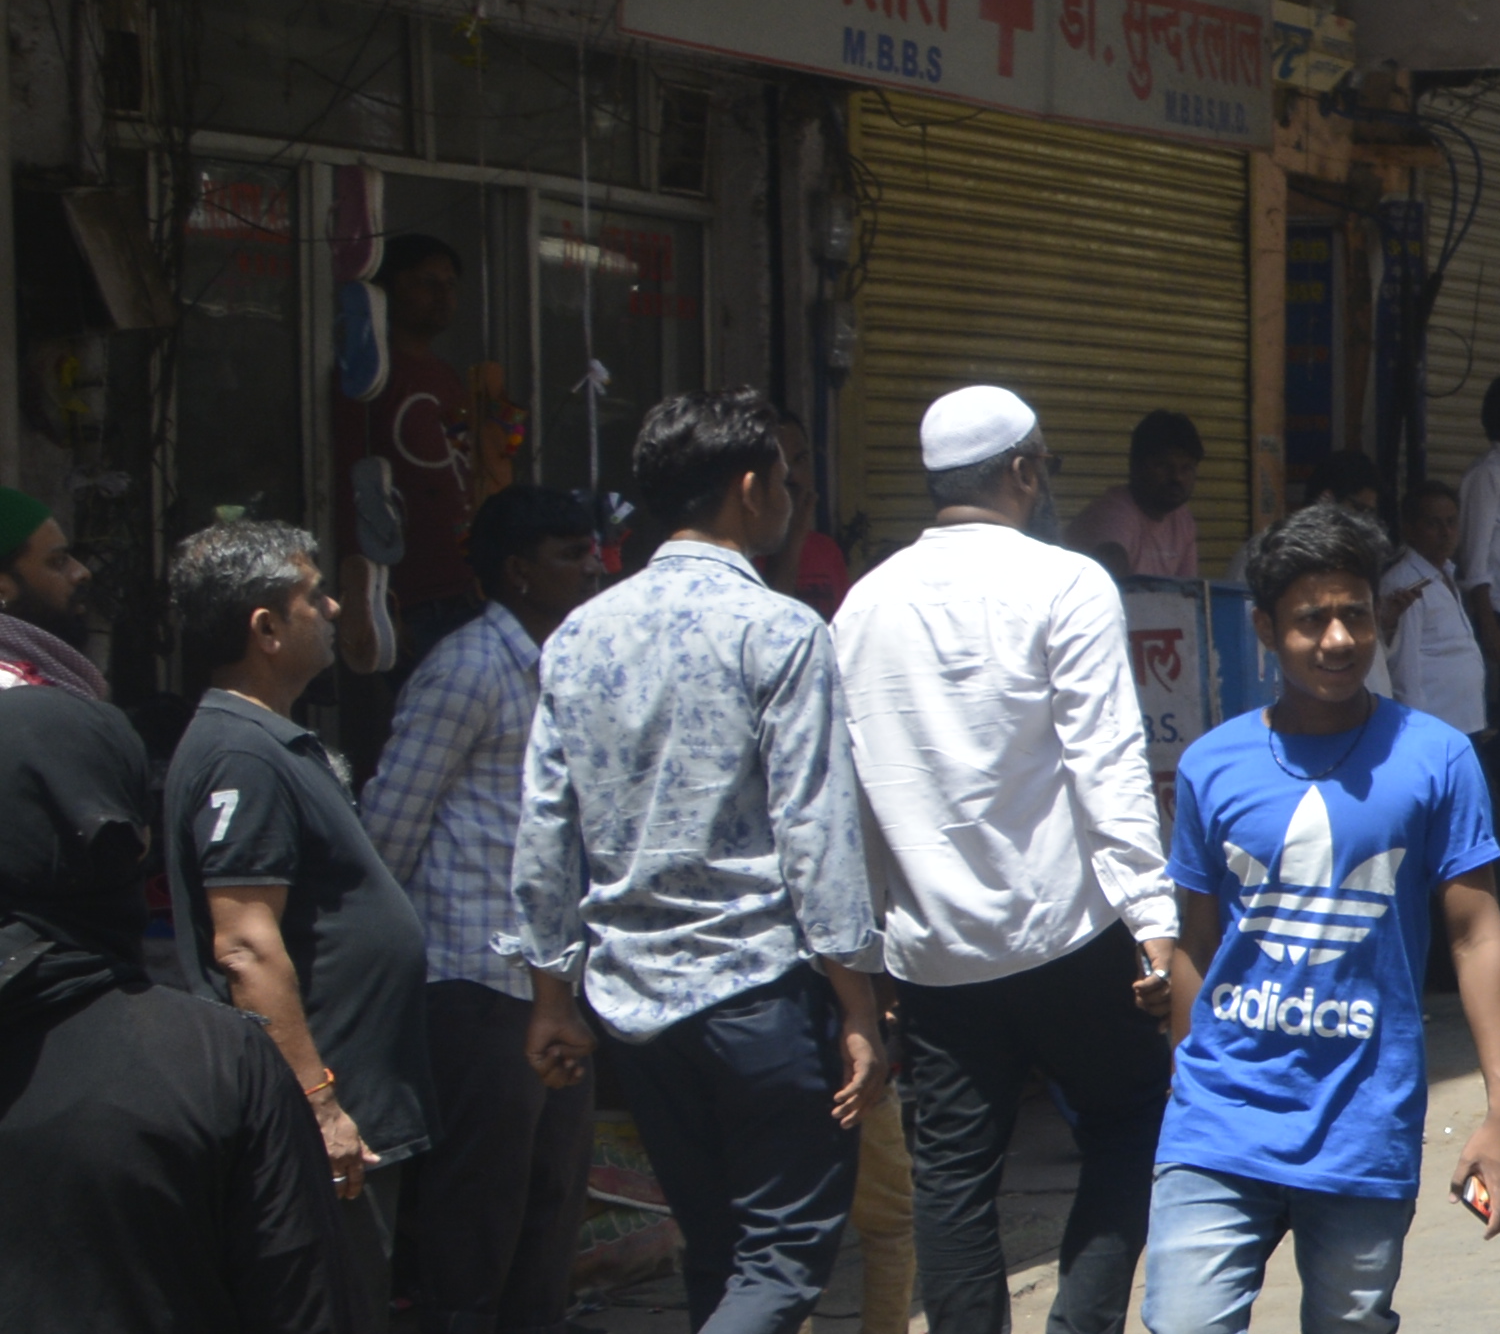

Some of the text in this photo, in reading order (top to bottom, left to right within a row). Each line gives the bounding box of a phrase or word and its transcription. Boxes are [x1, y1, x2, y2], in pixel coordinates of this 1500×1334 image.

[843, 26, 944, 84] M.B.B.S
[211, 788, 240, 842] 7
[1210, 983, 1375, 1040] adidas
